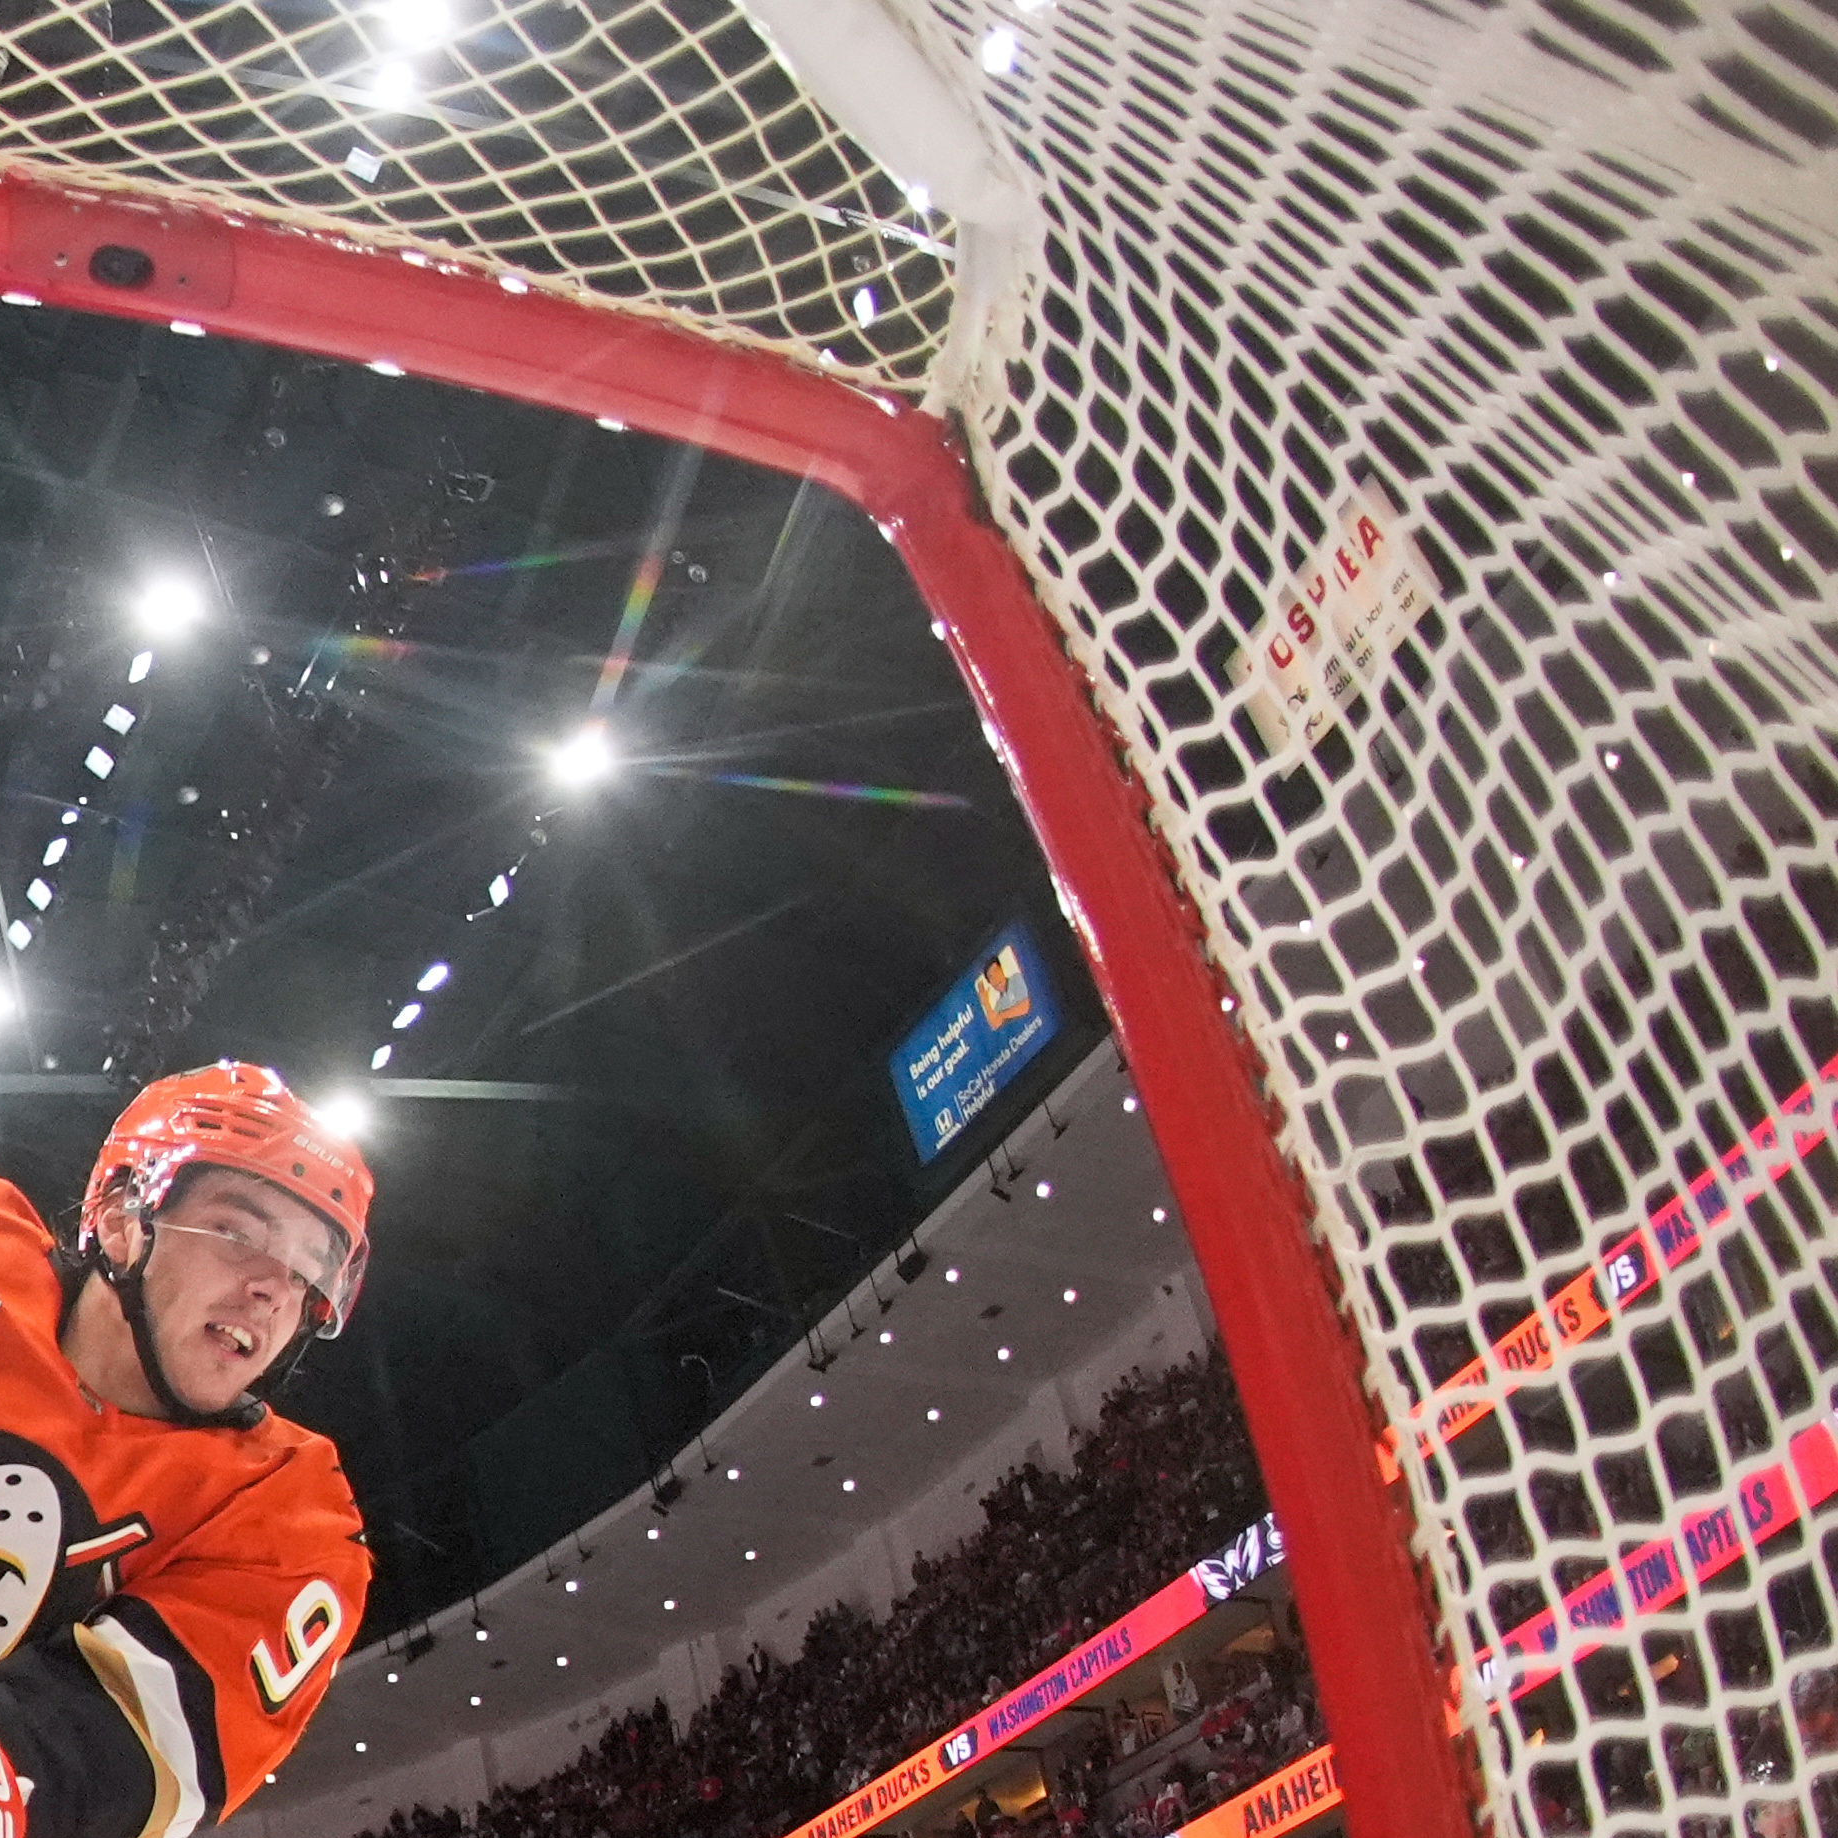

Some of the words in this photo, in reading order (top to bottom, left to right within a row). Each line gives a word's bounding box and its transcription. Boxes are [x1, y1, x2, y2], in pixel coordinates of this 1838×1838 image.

[908, 1042, 941, 1080] Being
[937, 1003, 975, 1049] helpful
[916, 1084, 927, 1101] is
[926, 1069, 945, 1091] our
[943, 1039, 971, 1076] goal.
[958, 1072, 982, 1103] SoCal
[981, 1047, 1011, 1081] Honda
[1009, 1015, 1044, 1054] Dealers
[962, 1079, 995, 1121] Helpful
[877, 1758, 932, 1811] DUCKS
[944, 1732, 973, 1768] VS
